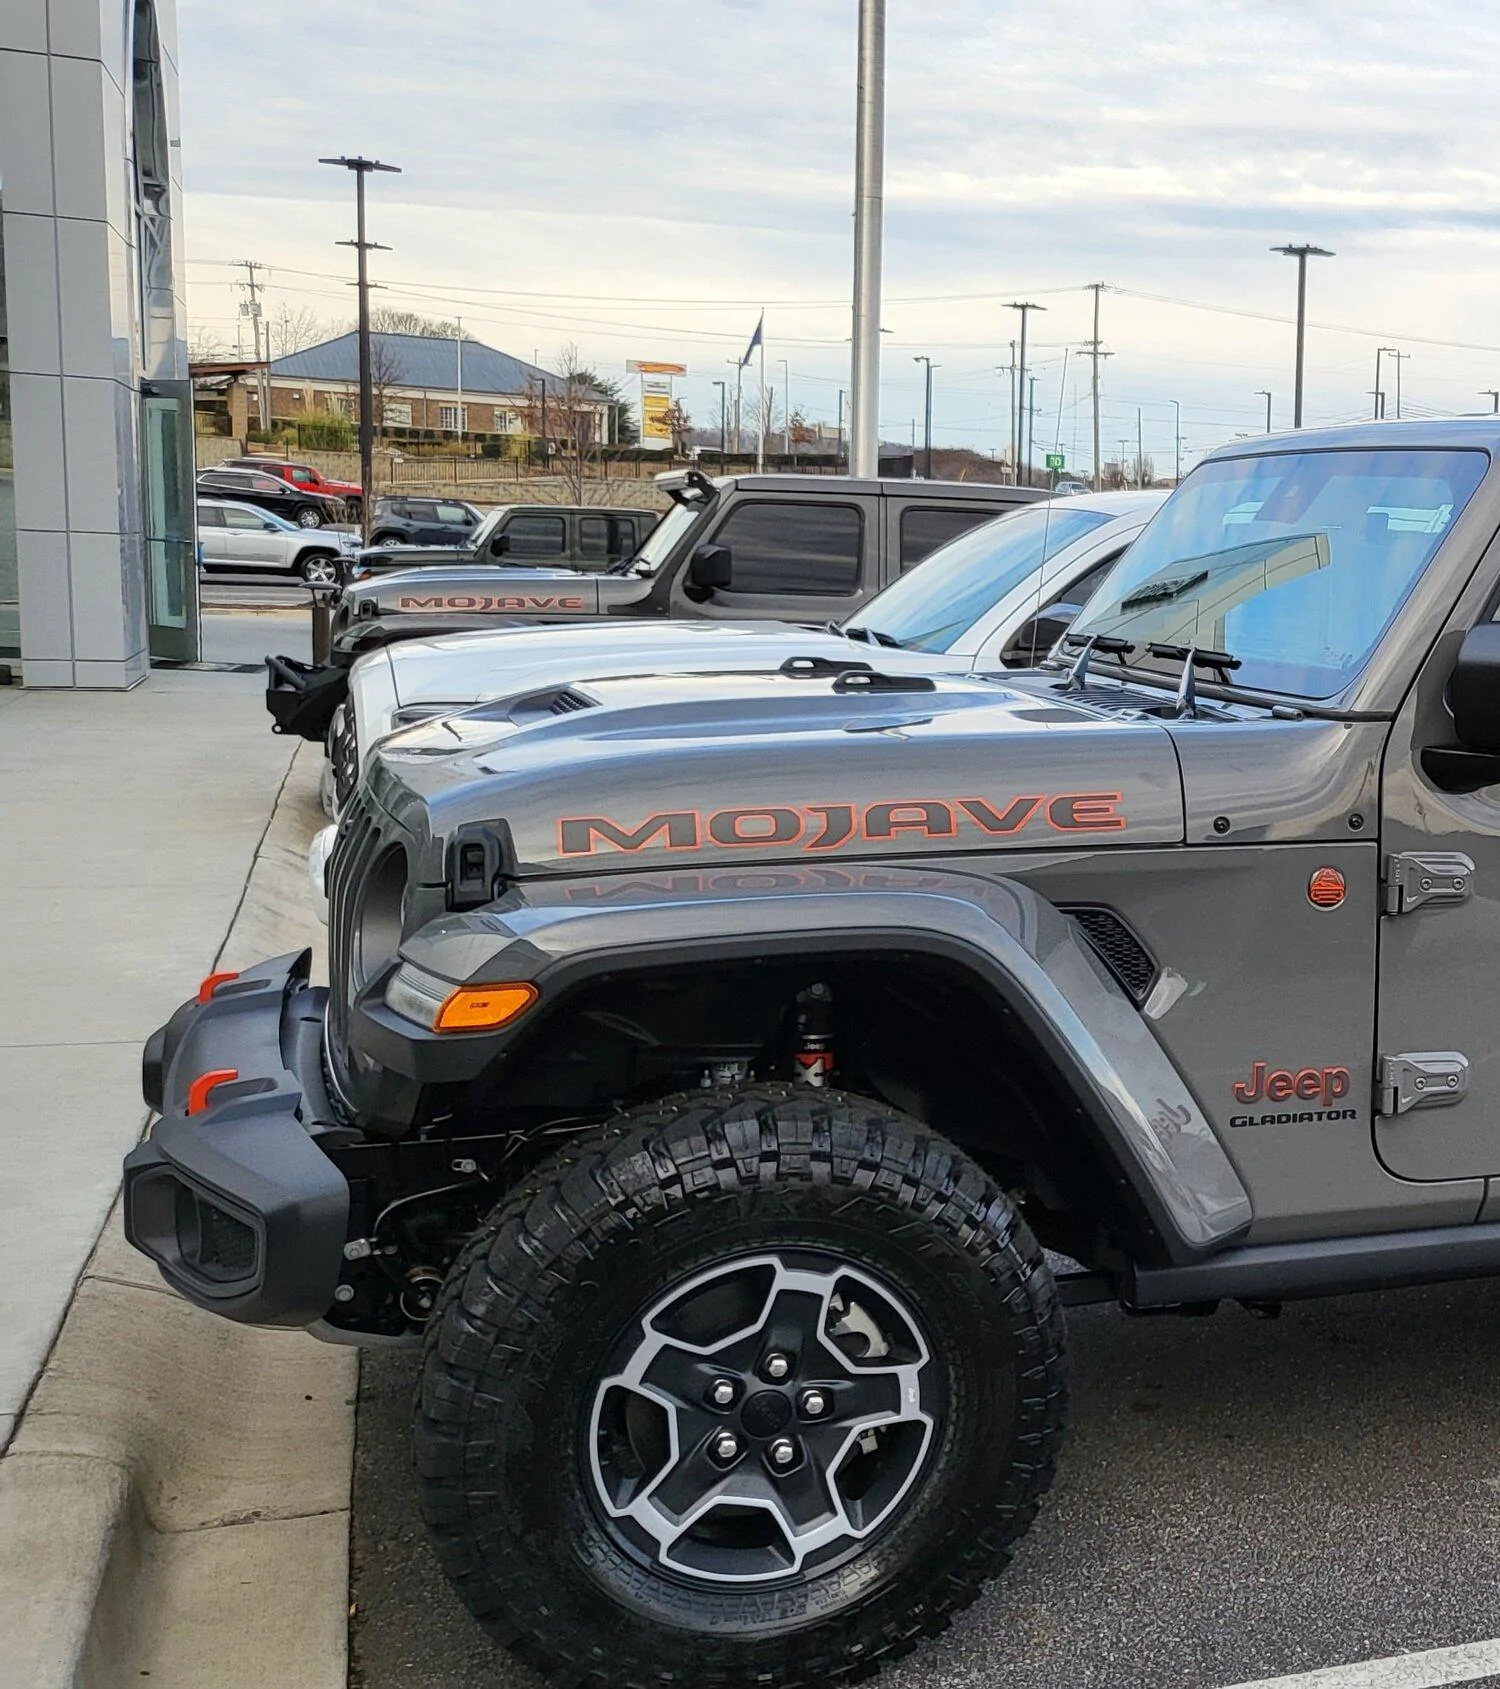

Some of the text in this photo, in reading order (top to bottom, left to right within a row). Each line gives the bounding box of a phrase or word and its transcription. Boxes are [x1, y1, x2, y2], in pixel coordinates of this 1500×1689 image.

[399, 596, 584, 611] MOJAVE
[557, 792, 1127, 857] MOJAVE
[1231, 1060, 1350, 1107] Jeep
[1229, 1109, 1357, 1128] GLADIATOR
